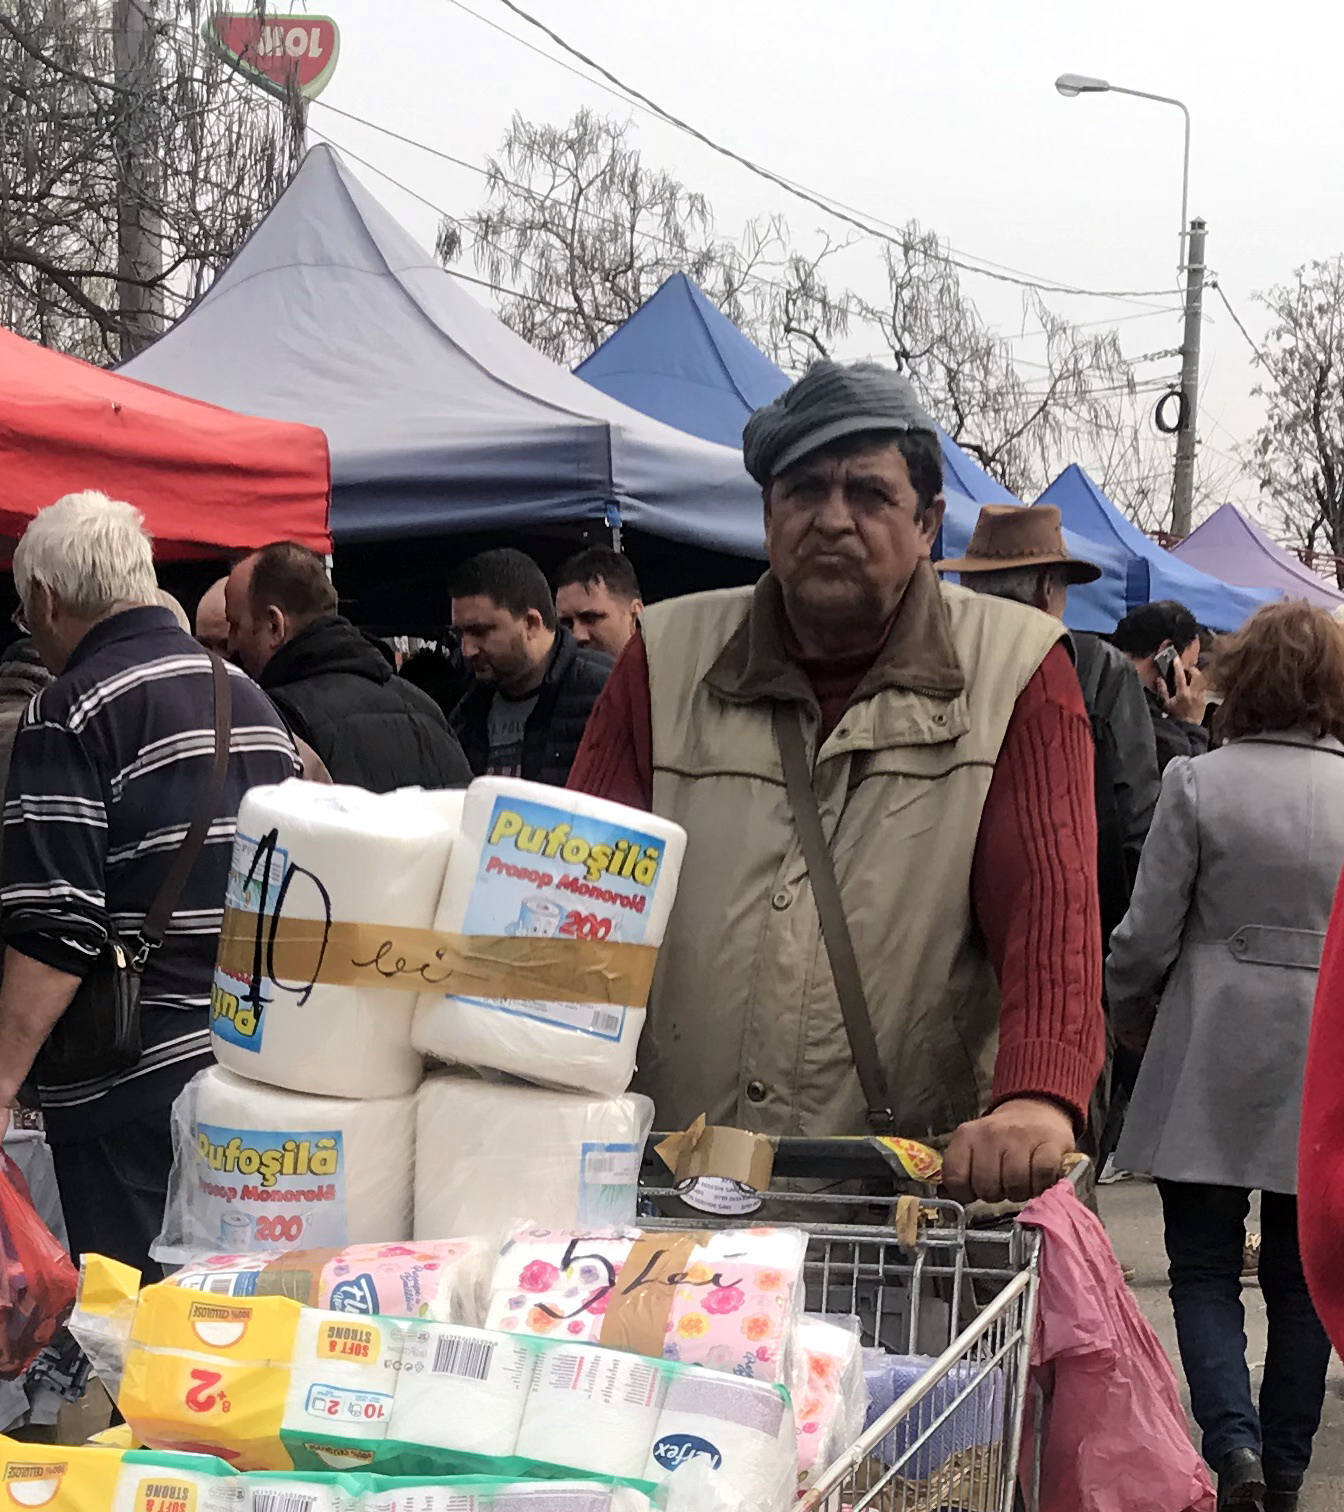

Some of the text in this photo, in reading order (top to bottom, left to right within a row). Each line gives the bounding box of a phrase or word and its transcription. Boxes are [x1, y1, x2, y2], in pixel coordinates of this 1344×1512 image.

[486, 856, 553, 889] Prosop
[559, 910, 612, 942] 200
[351, 940, 454, 984] lei
[253, 1215, 304, 1242] 200
[533, 1237, 645, 1319] 5
[327, 1326, 372, 1344] STRONG
[339, 1342, 370, 1358] SOFT
[327, 1399, 385, 1419] 10 2
[655, 1443, 719, 1468] rfex
[144, 1484, 190, 1500] STRONG
